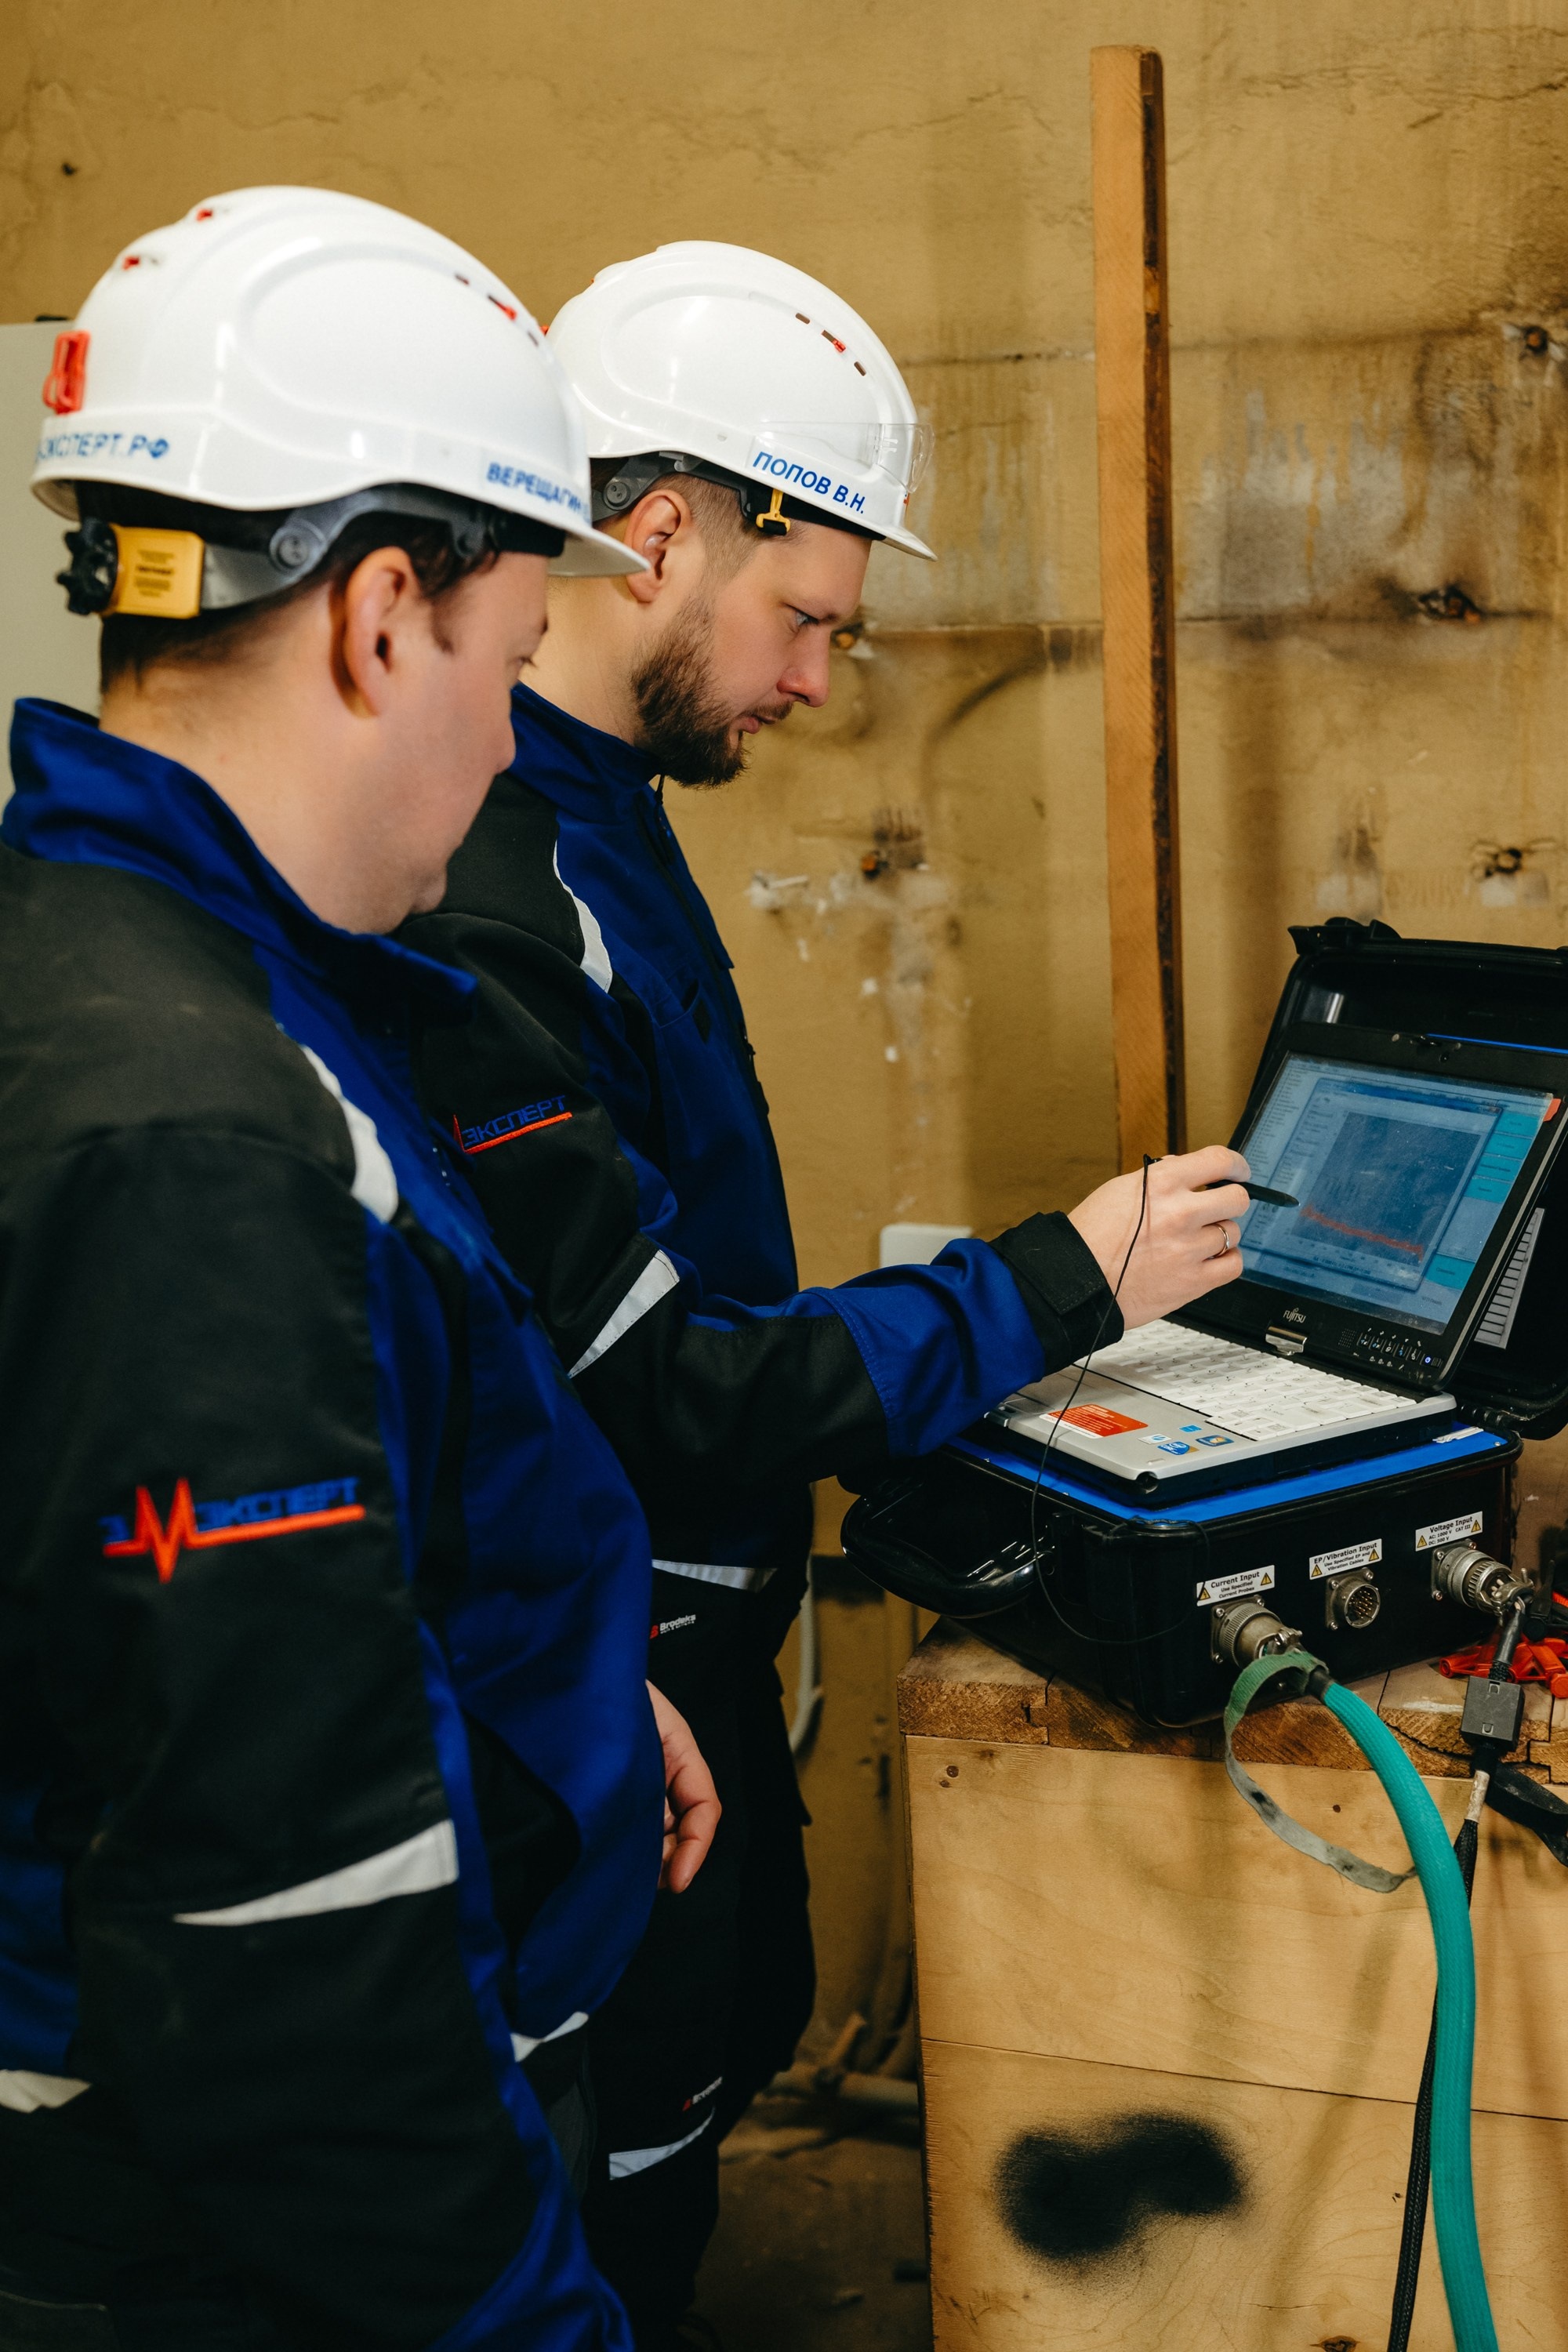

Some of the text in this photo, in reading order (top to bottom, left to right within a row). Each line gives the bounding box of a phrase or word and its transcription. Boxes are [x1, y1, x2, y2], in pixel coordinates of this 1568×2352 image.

[752, 452, 866, 514] ПОПОВ В.Н.
[1283, 1308, 1307, 1323] FUJITSU
[1429, 1516, 1472, 1533] Voltage Input
[1314, 1542, 1377, 1564] EP/Vibration Input
[1334, 1555, 1354, 1565] Specified
[1327, 1563, 1348, 1571] Vibration
[1210, 1571, 1260, 1588] Current Input
[1231, 1581, 1254, 1590] Specified
